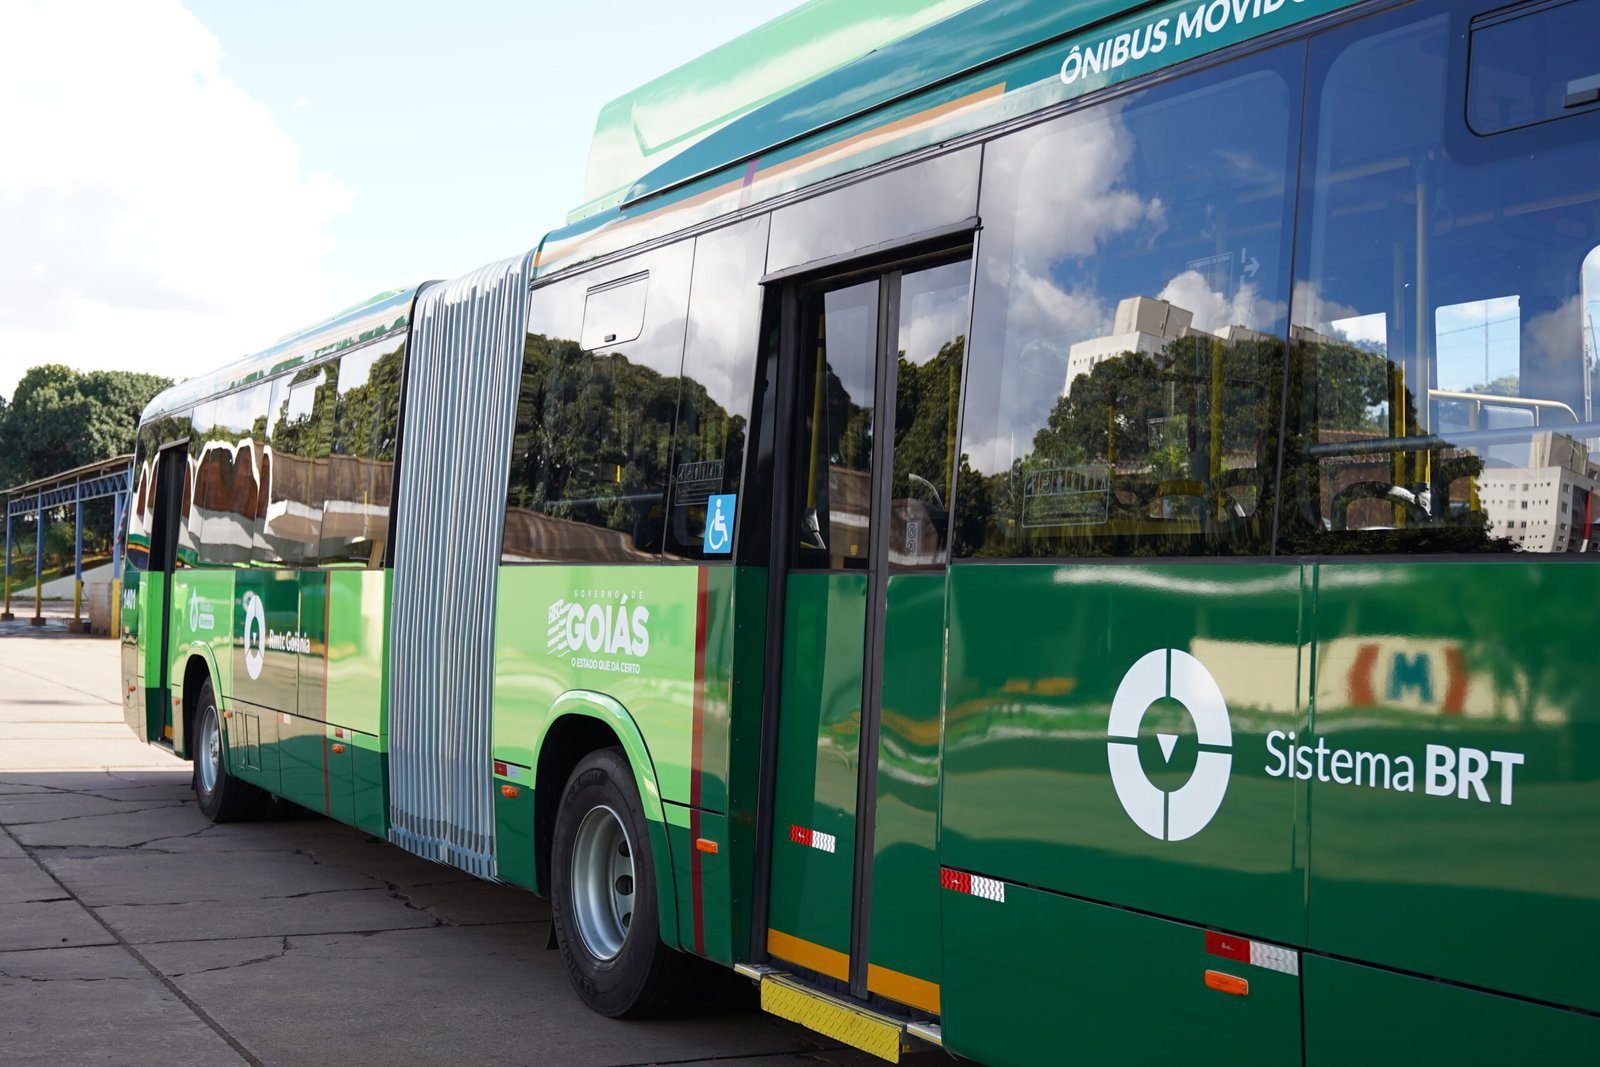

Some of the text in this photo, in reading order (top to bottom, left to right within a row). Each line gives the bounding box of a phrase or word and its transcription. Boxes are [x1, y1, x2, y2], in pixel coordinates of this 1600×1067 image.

[1060, 0, 1306, 85] ÔNIBUS MOVI
[566, 593, 650, 658] GOIÁS
[573, 589, 644, 600] GOVERNO DE
[571, 657, 641, 675] O ESTADO QUE DÁ CERTO
[1264, 729, 1526, 807] Sistema BRT
